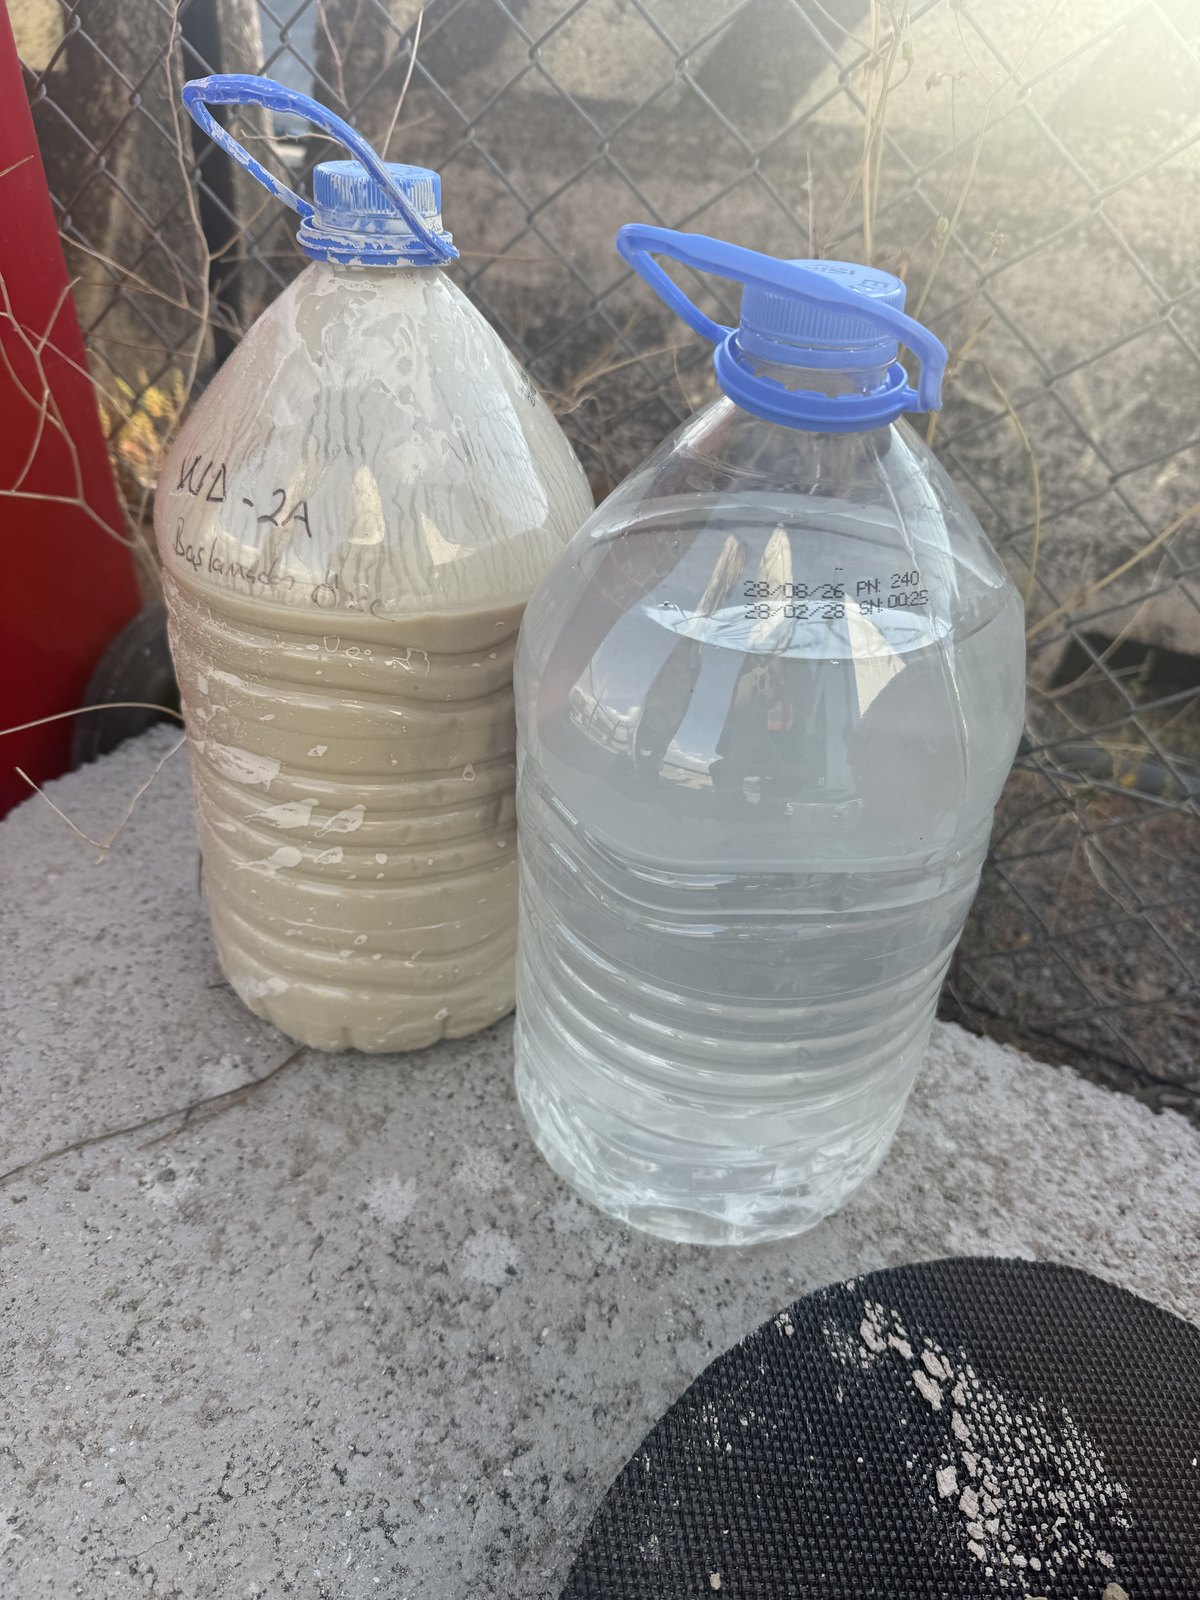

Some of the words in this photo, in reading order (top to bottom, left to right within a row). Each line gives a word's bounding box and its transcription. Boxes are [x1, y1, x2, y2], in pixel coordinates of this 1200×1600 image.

[743, 580, 845, 598] 28/08/26
[856, 578, 881, 597] PN:
[890, 570, 920, 590] 240
[743, 603, 845, 620] 28/02/28
